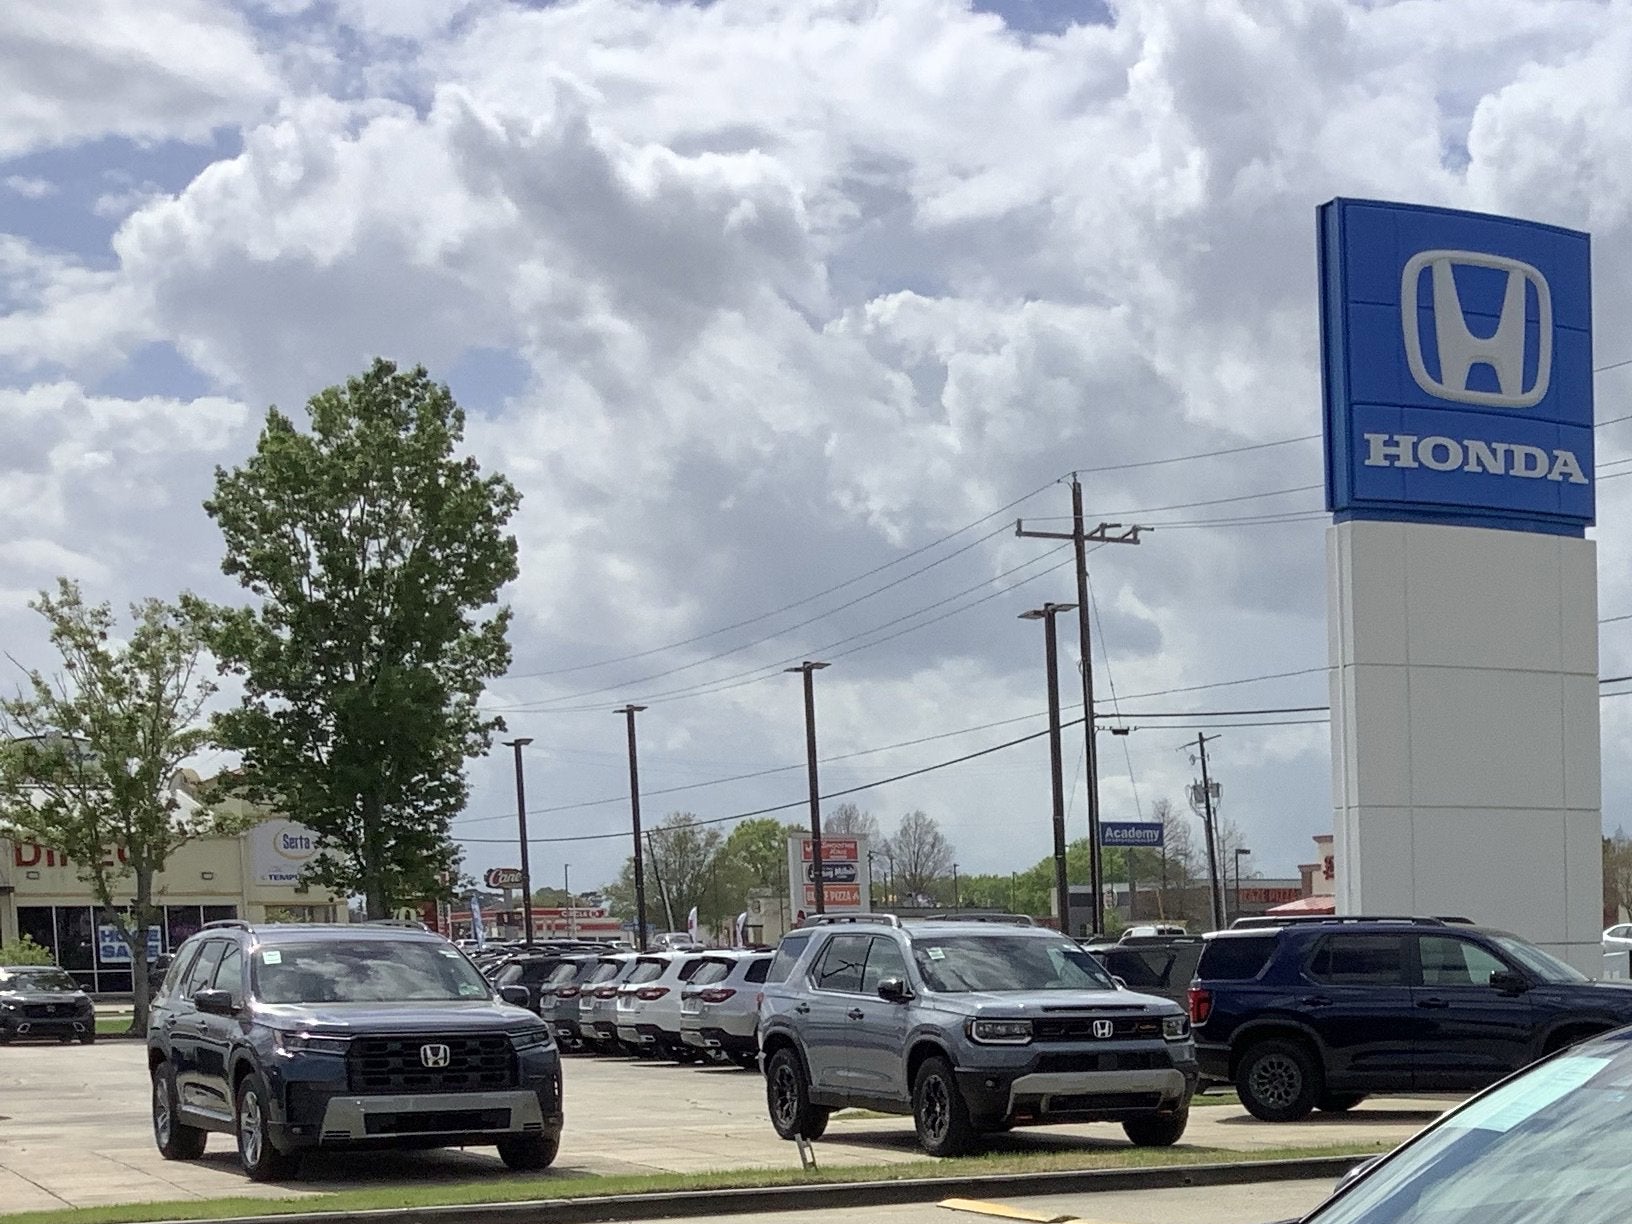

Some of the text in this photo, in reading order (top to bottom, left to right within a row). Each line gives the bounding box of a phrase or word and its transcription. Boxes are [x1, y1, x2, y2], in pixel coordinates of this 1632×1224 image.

[1364, 433, 1589, 485] HONDA
[282, 833, 310, 850] Serta
[1105, 826, 1160, 842] Academy
[102, 945, 159, 959] SAE
